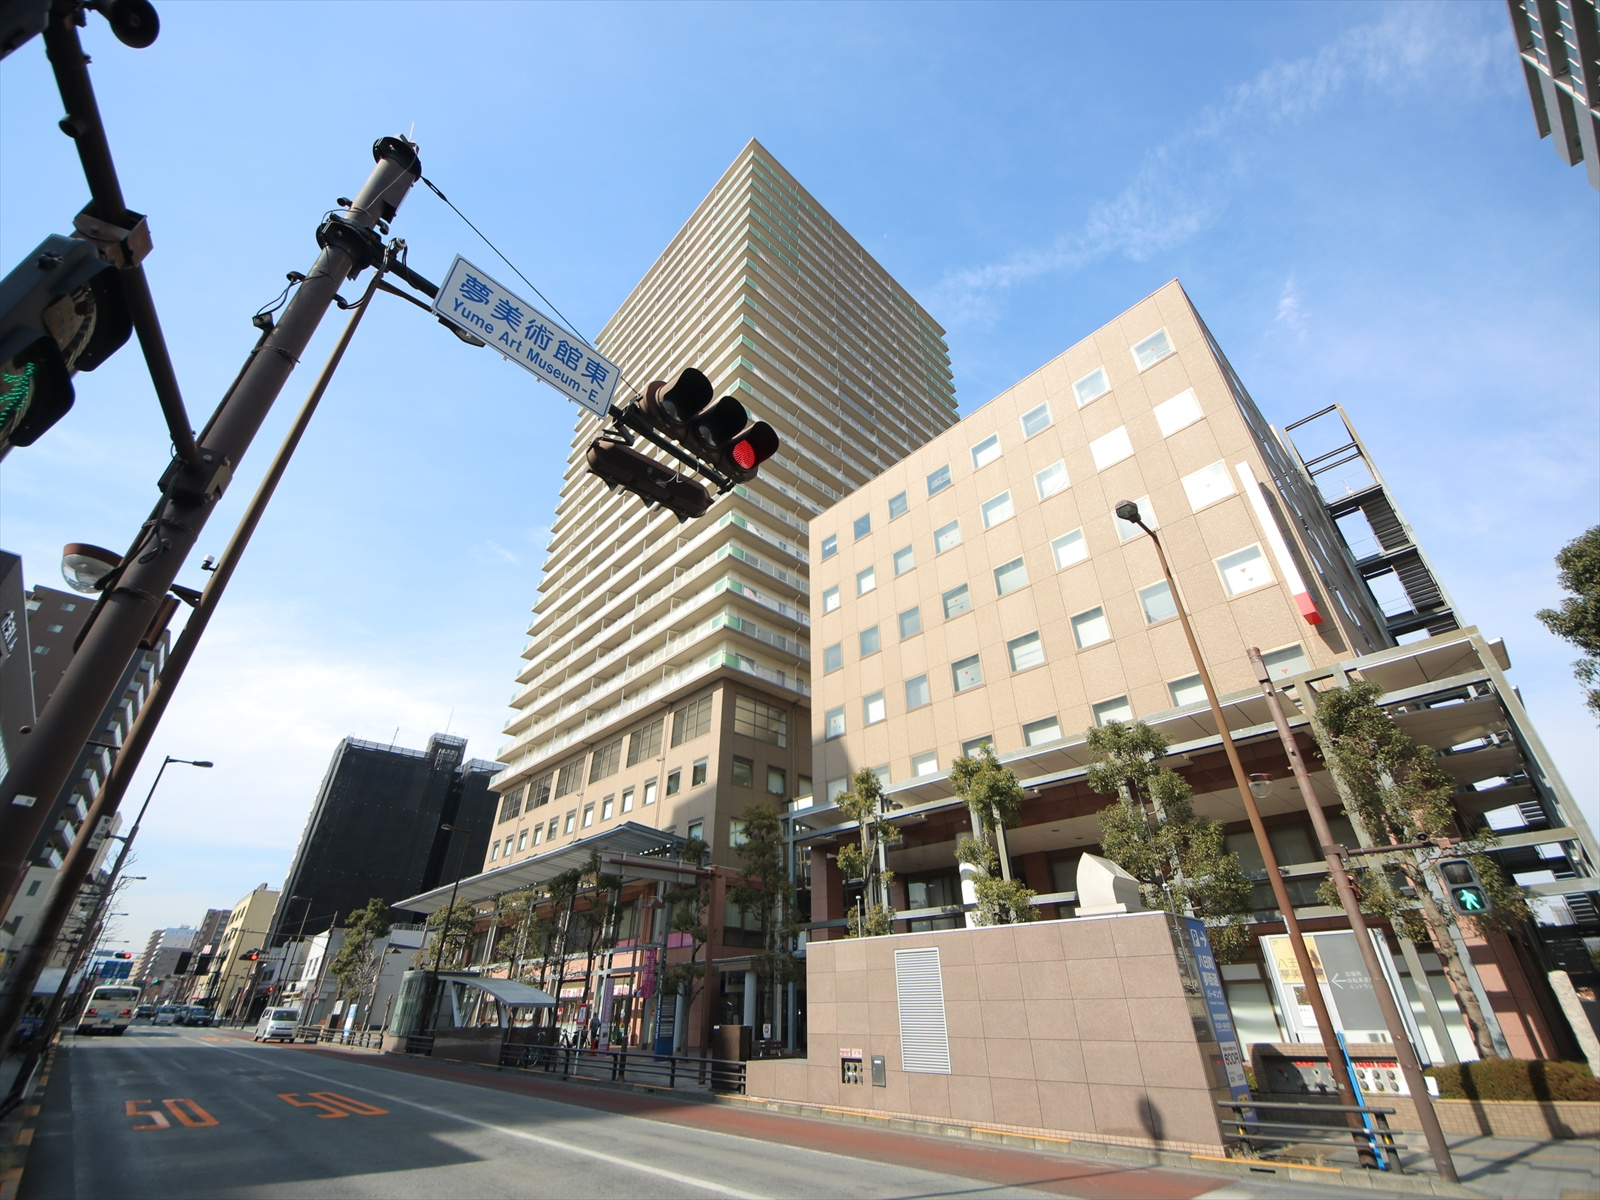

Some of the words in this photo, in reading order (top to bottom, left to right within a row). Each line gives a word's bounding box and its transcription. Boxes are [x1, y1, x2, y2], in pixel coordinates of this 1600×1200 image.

[452, 297, 494, 334] Yume
[498, 331, 523, 353] Art
[459, 273, 610, 390] 夢美術館東
[125, 1099, 220, 1130] 50
[277, 1092, 389, 1118] 50
